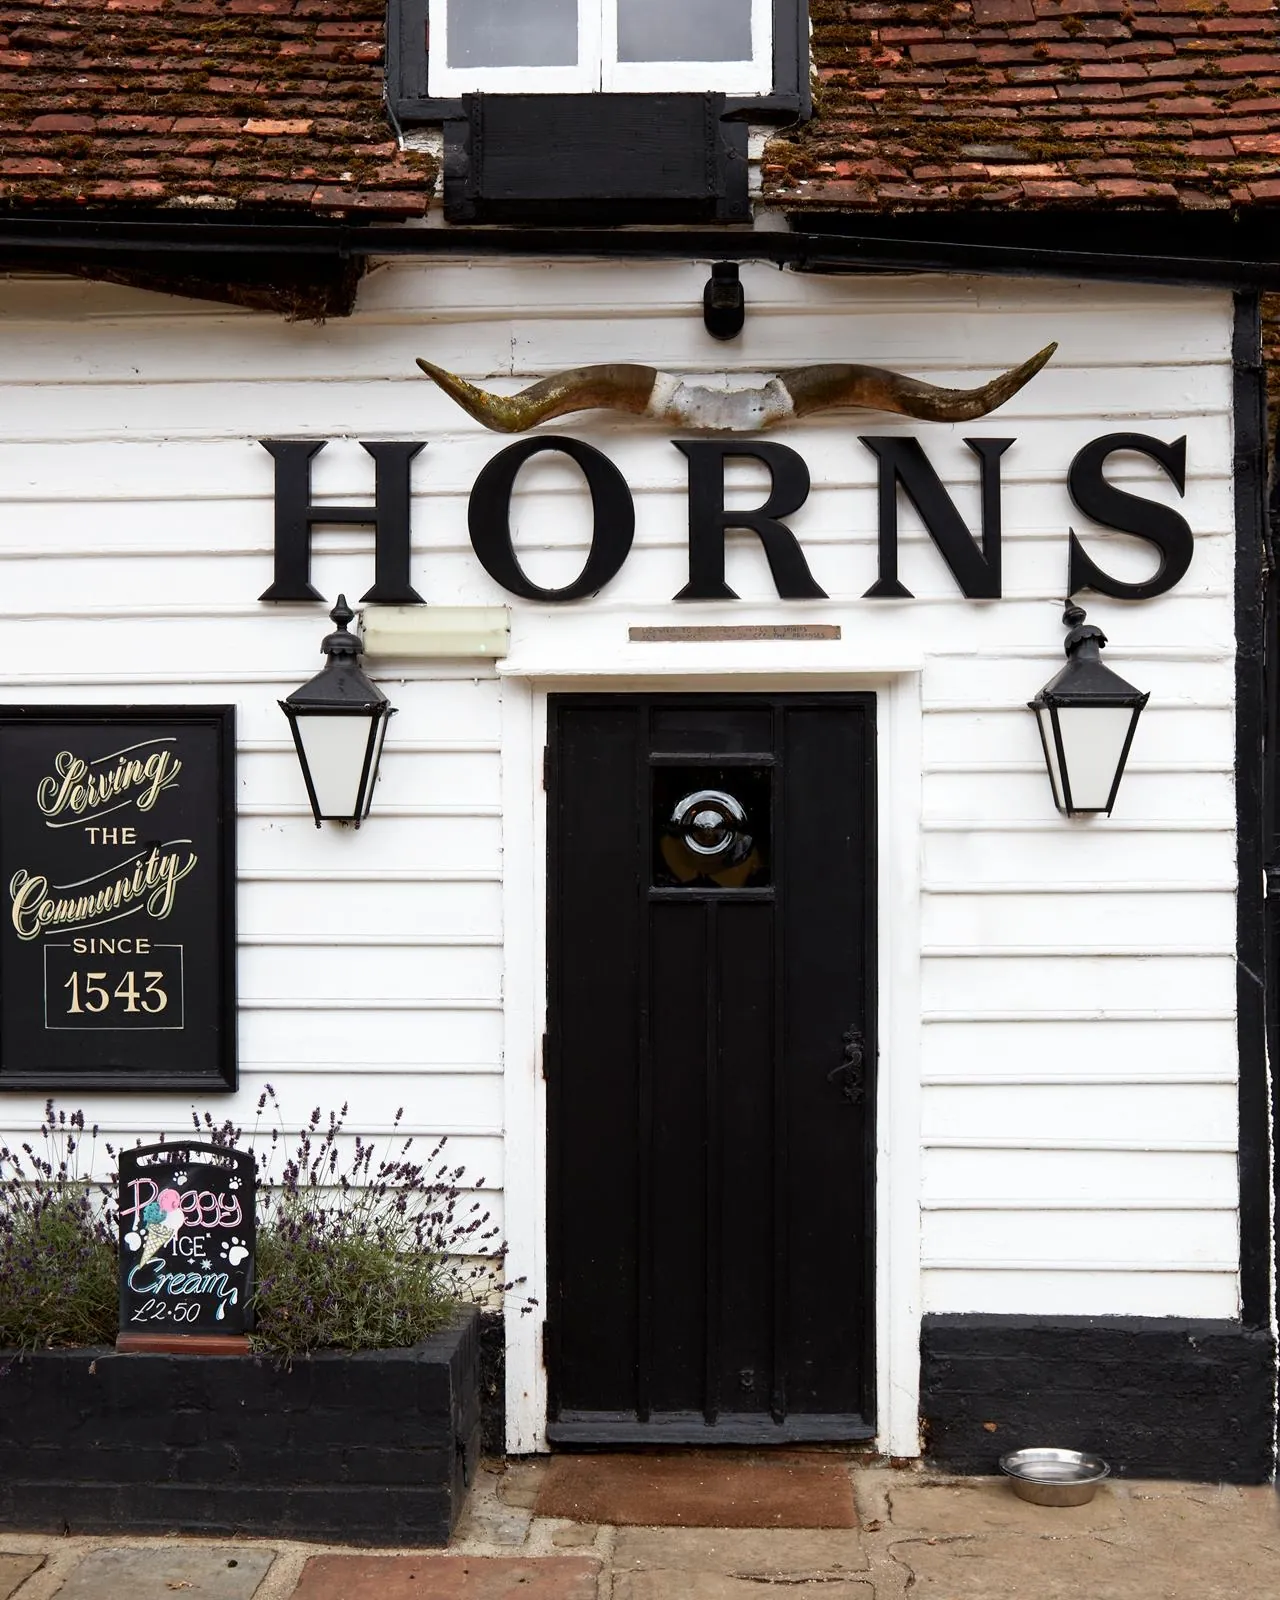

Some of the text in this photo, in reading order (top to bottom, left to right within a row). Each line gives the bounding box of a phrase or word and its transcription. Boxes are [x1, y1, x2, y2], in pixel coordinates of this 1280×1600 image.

[257, 432, 1194, 605] HORNS
[37, 750, 182, 815] Serving
[85, 827, 137, 845] THE
[10, 846, 198, 940] Community
[72, 938, 151, 954] SINCE
[64, 970, 168, 1014] 1543
[166, 1235, 207, 1257] ICE
[128, 1258, 238, 1306] Cream
